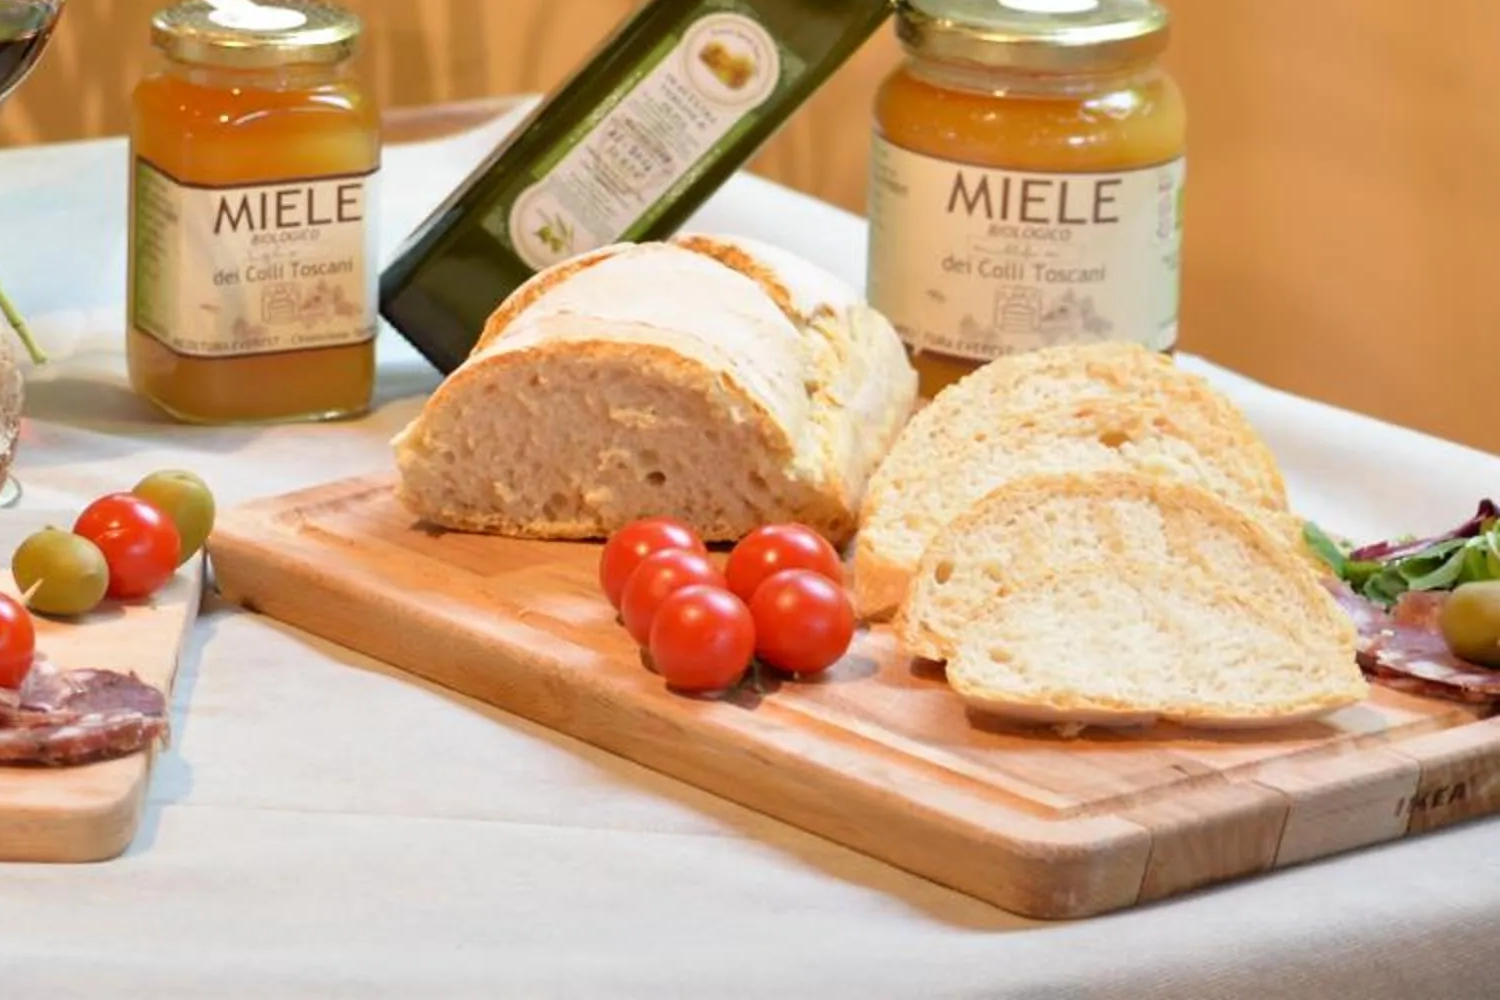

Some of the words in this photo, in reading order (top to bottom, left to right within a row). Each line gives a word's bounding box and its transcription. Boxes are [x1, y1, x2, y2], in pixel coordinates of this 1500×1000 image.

[213, 183, 364, 235] MIELE
[947, 170, 1123, 225] MIELE
[251, 228, 321, 246] BIOLOGICO
[987, 225, 1073, 241] BIOLOGICO
[212, 267, 240, 286] dei
[245, 262, 285, 282] Colli
[290, 259, 354, 279] Toscani
[940, 254, 971, 275] dei
[977, 259, 1024, 281] Colli
[1032, 262, 1107, 284] Toscani
